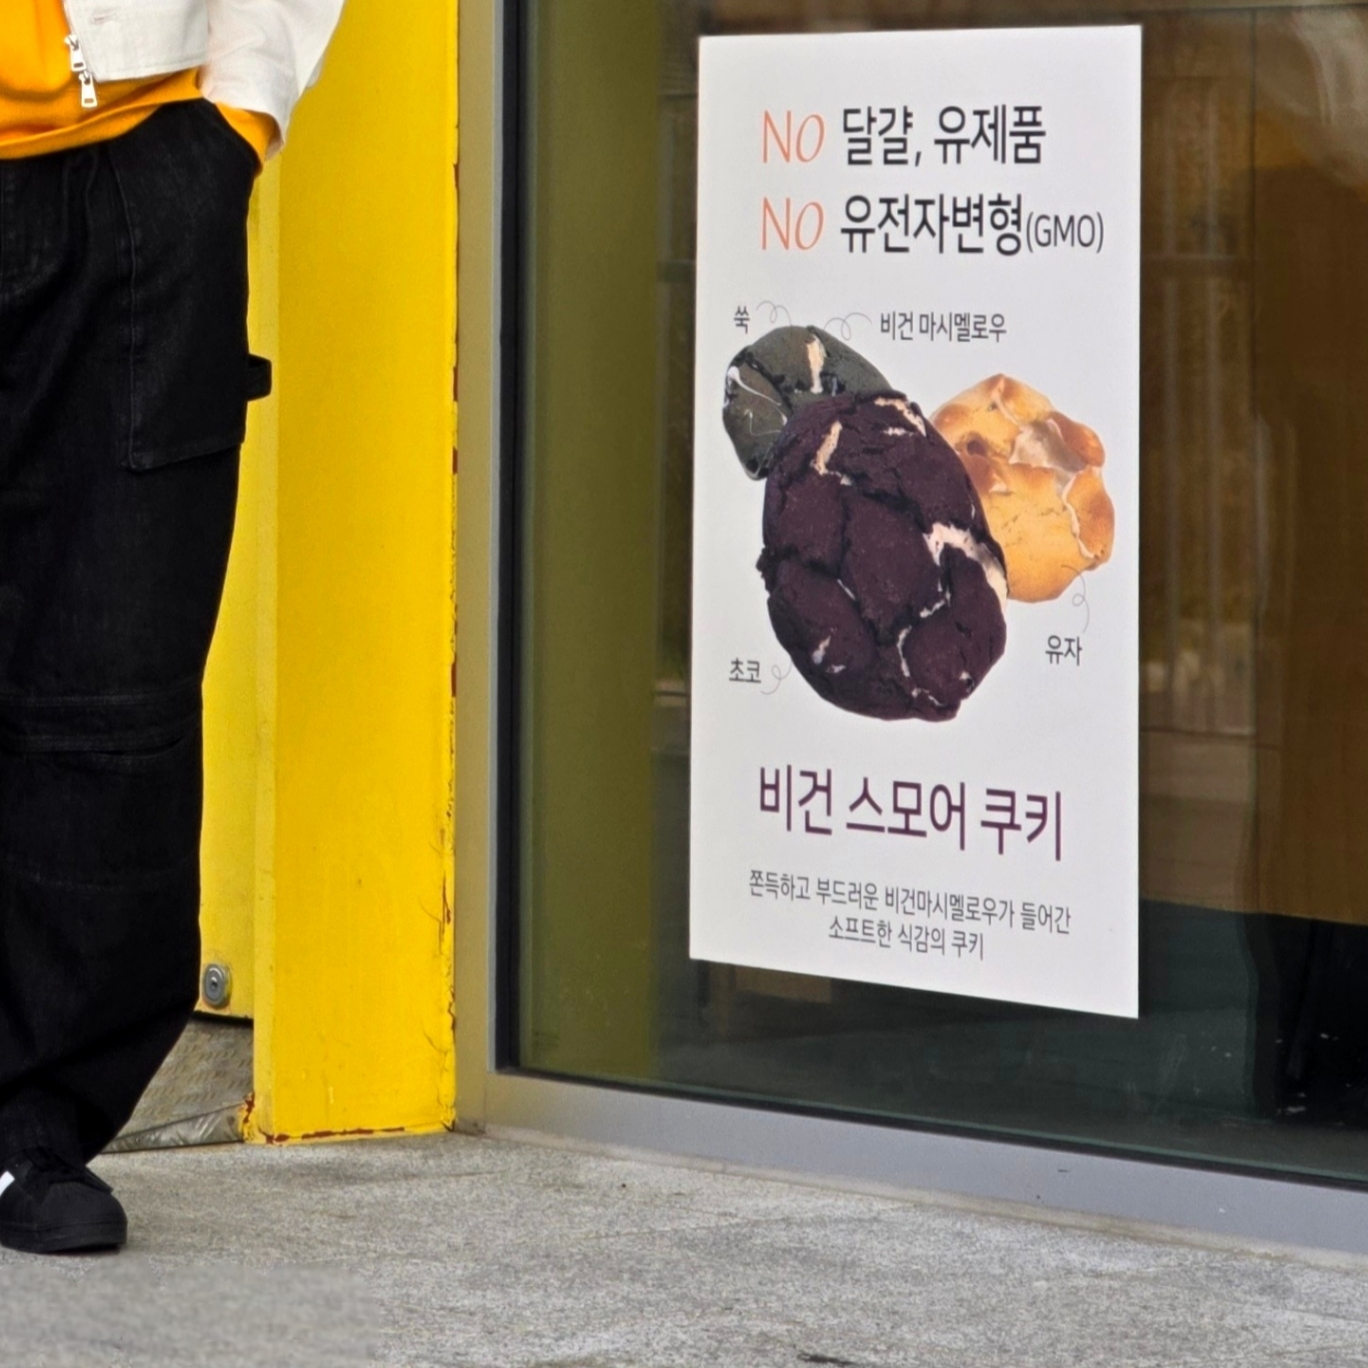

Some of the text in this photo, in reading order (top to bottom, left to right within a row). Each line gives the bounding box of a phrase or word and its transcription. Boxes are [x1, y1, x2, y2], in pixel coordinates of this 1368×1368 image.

[762, 104, 1046, 167] NO 달걀, 유제품
[761, 193, 1104, 256] NO 유전자변형(GMO)
[734, 306, 750, 334] 쑥
[881, 311, 1007, 343] 비건 마시멜로우
[728, 656, 762, 684] 초코
[1045, 635, 1082, 666] 유자
[760, 764, 1061, 862] 비건 스모어 쿠키
[749, 870, 1072, 935] 쫀득하고 부드러운 비건마시멜로우가 들어간
[828, 915, 983, 961] 소프트한 식감의 쿠키
